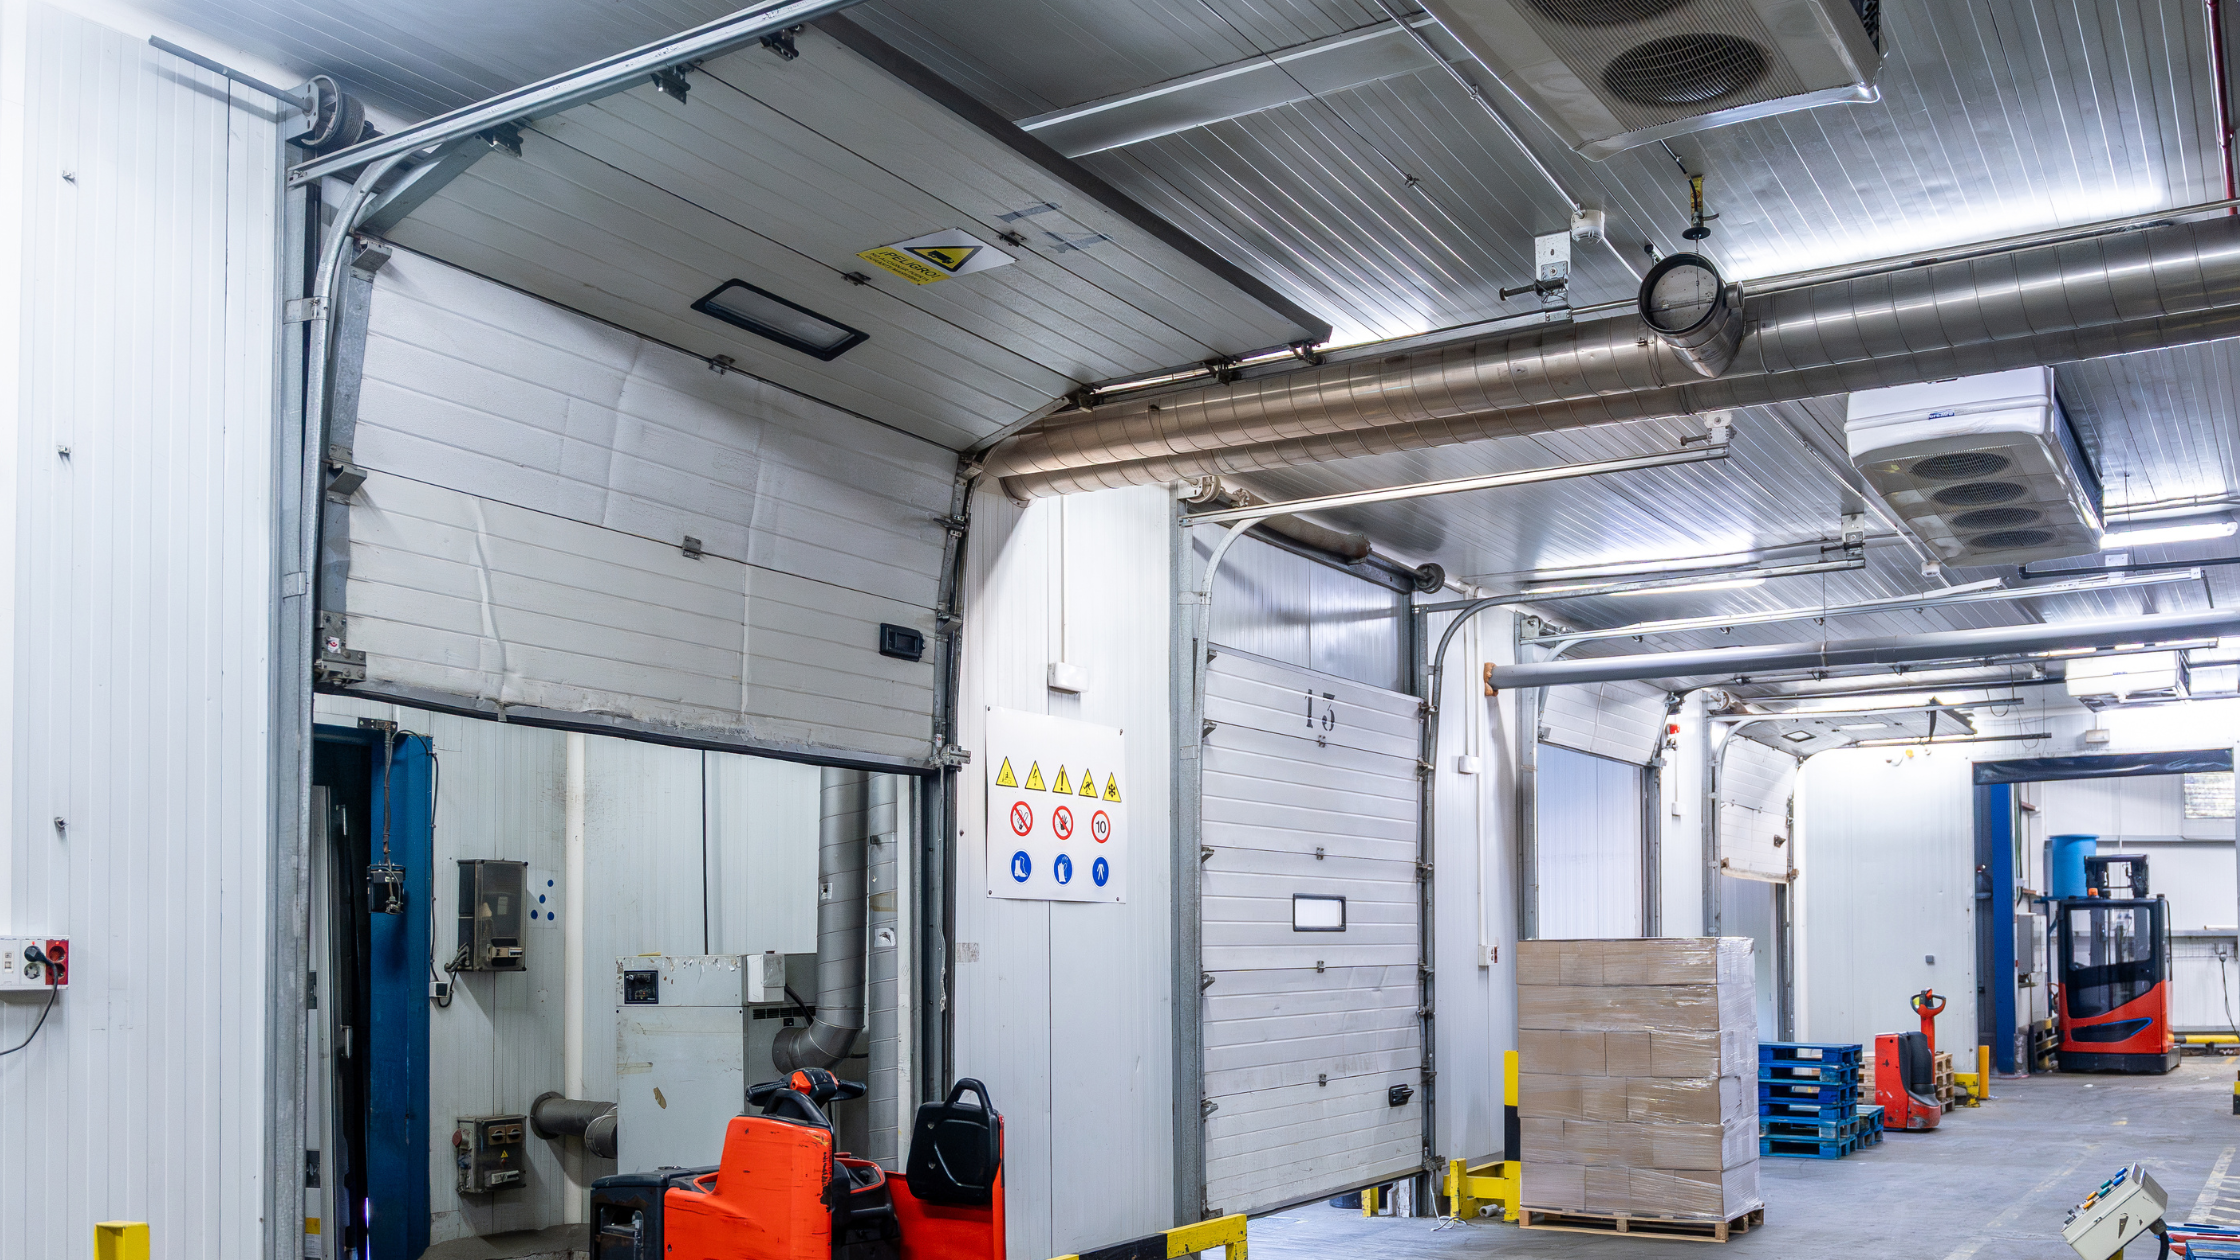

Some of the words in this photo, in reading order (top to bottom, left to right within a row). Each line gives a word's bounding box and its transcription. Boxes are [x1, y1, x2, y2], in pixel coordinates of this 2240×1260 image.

[878, 251, 942, 278] ¡PELIGRO!
[1304, 688, 1336, 732] 13
[1095, 820, 1107, 834] 10
